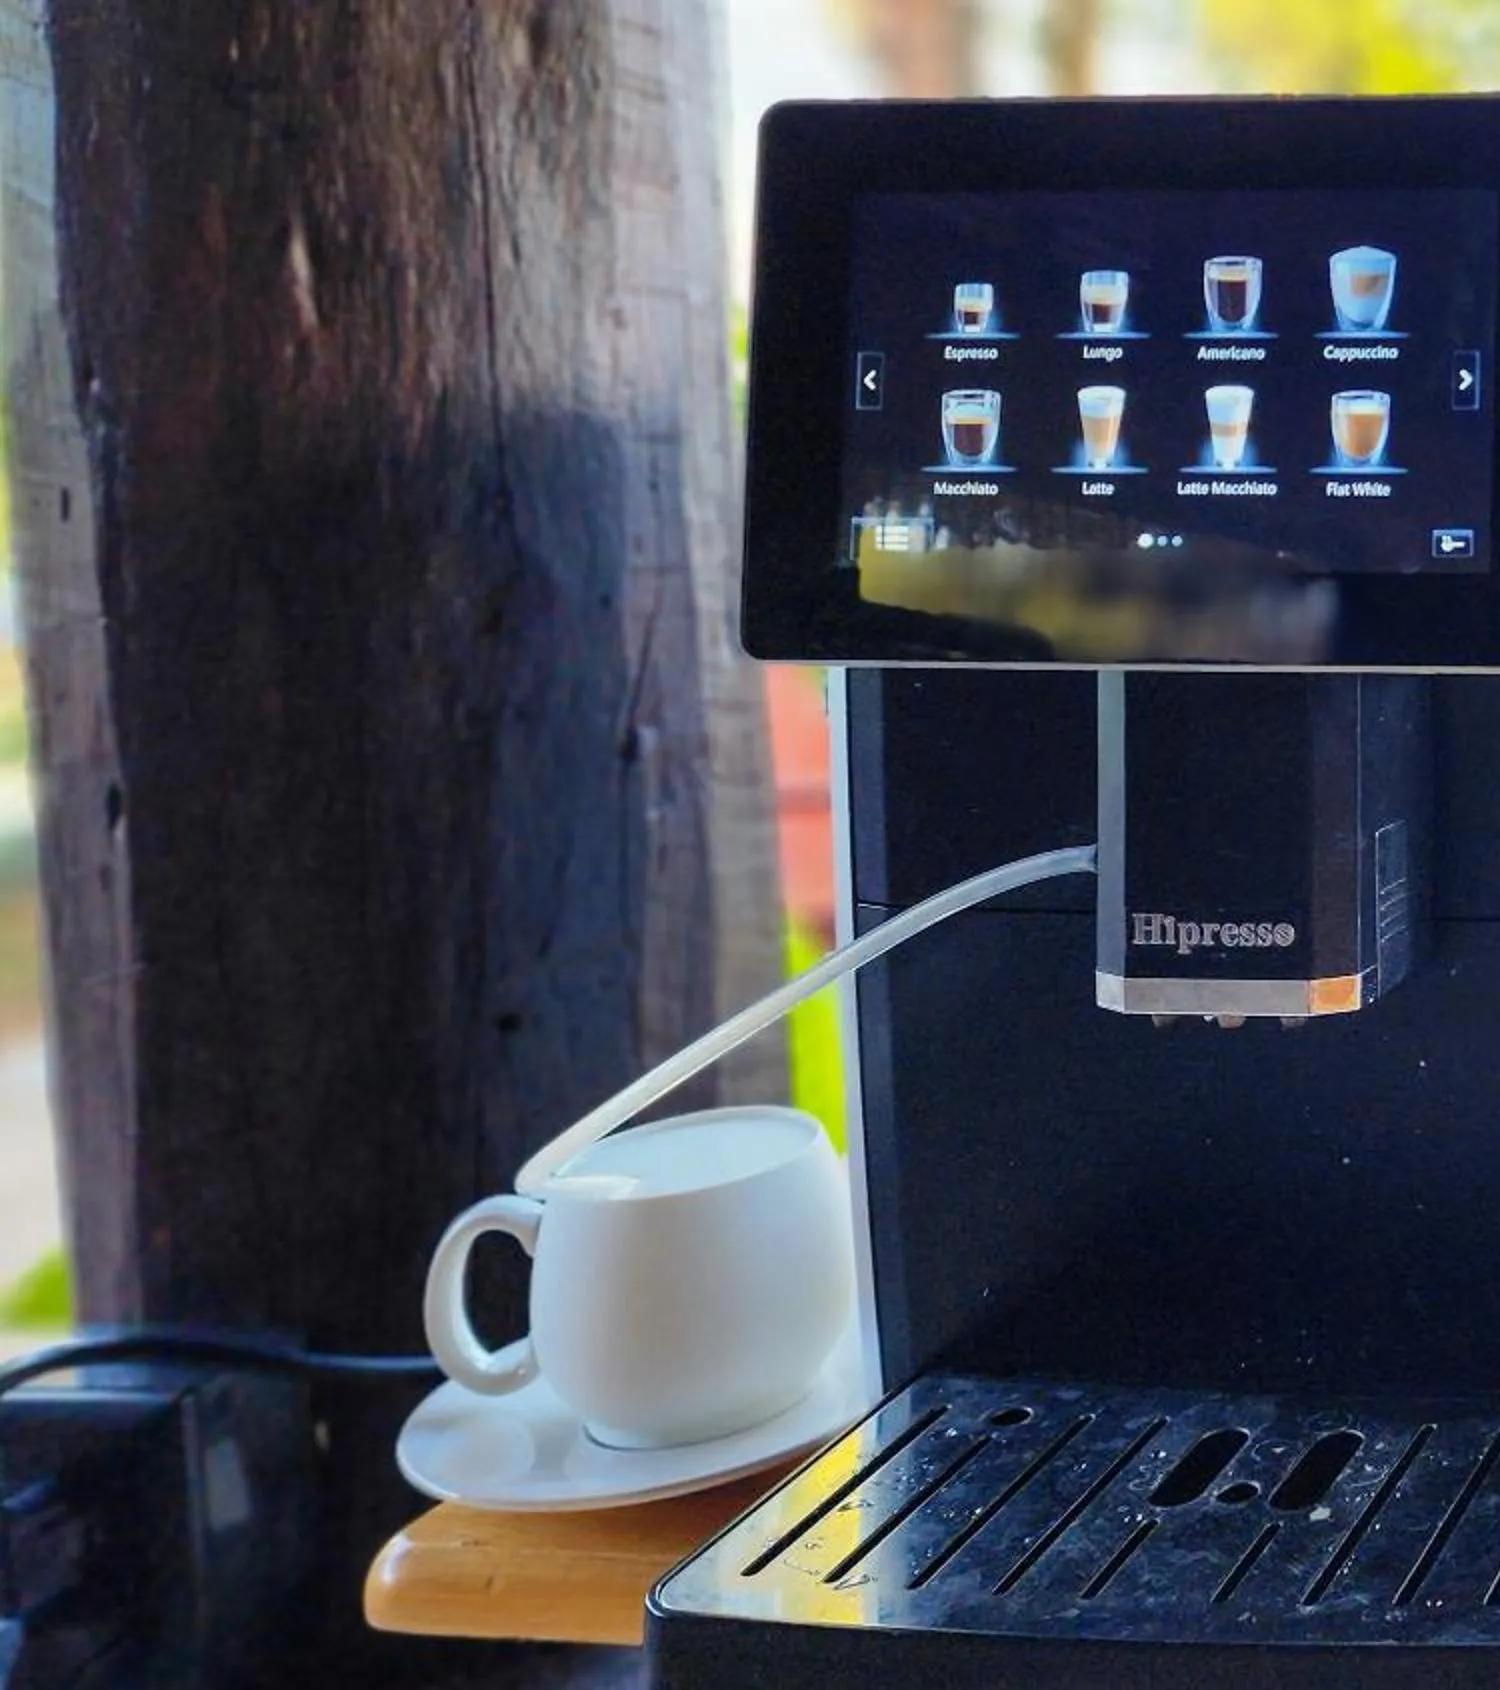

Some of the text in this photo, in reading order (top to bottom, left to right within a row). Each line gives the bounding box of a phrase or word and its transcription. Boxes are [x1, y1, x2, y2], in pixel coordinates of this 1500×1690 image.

[943, 345, 999, 362] Espresso
[1082, 345, 1124, 362] Lungo
[1197, 345, 1266, 361] Americano
[1323, 345, 1399, 362] Cappuccino
[933, 481, 999, 496] Macchiato
[1081, 481, 1115, 496] Latte
[1176, 481, 1278, 496] Latte Macchiato
[1325, 481, 1392, 497] Flat White
[1131, 912, 1297, 954] Hipresso
